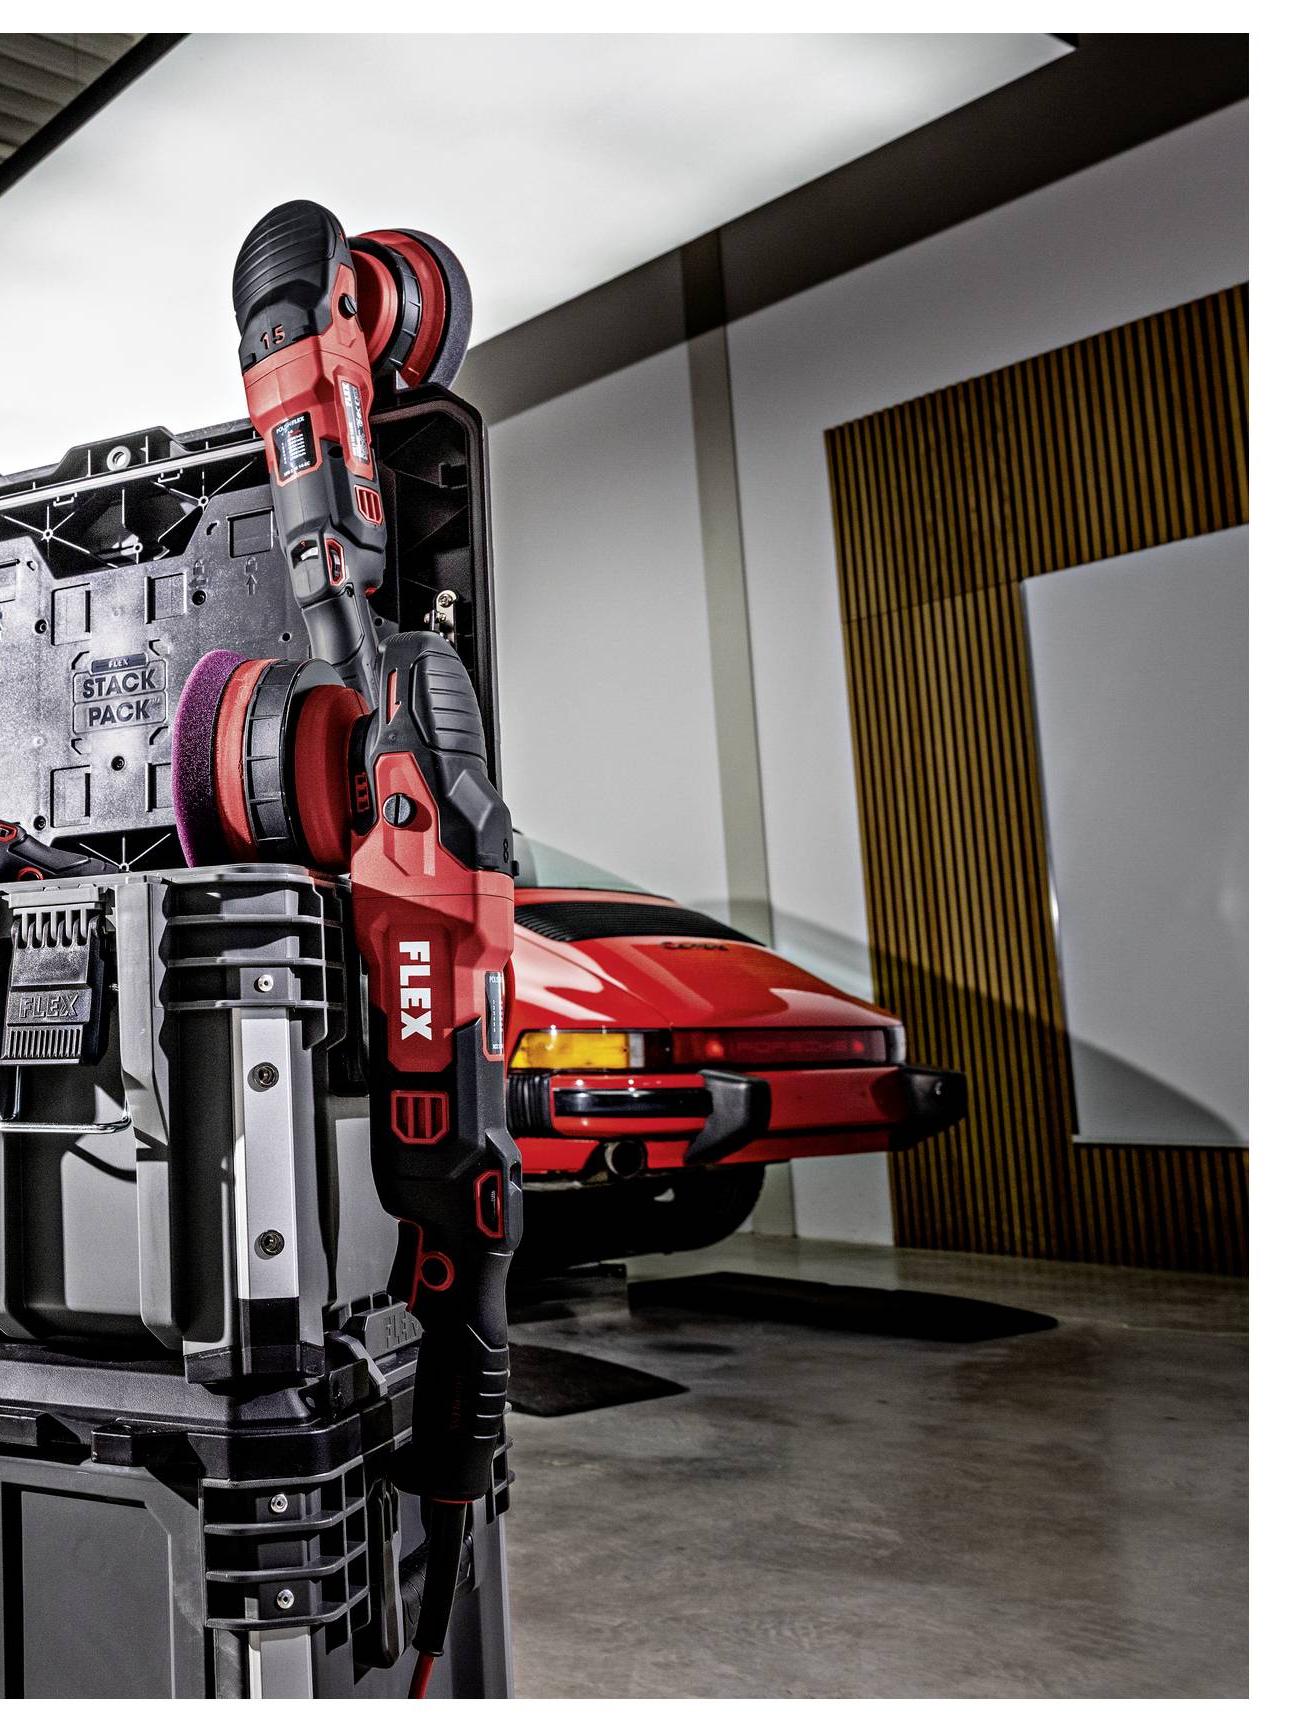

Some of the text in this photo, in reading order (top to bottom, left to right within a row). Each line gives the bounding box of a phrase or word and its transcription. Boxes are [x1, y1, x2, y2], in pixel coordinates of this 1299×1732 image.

[260, 323, 285, 350] 15
[108, 658, 130, 669] FLEX
[82, 668, 156, 699] STACK
[399, 941, 433, 1041] FLEX
[19, 992, 80, 1018] FLEX
